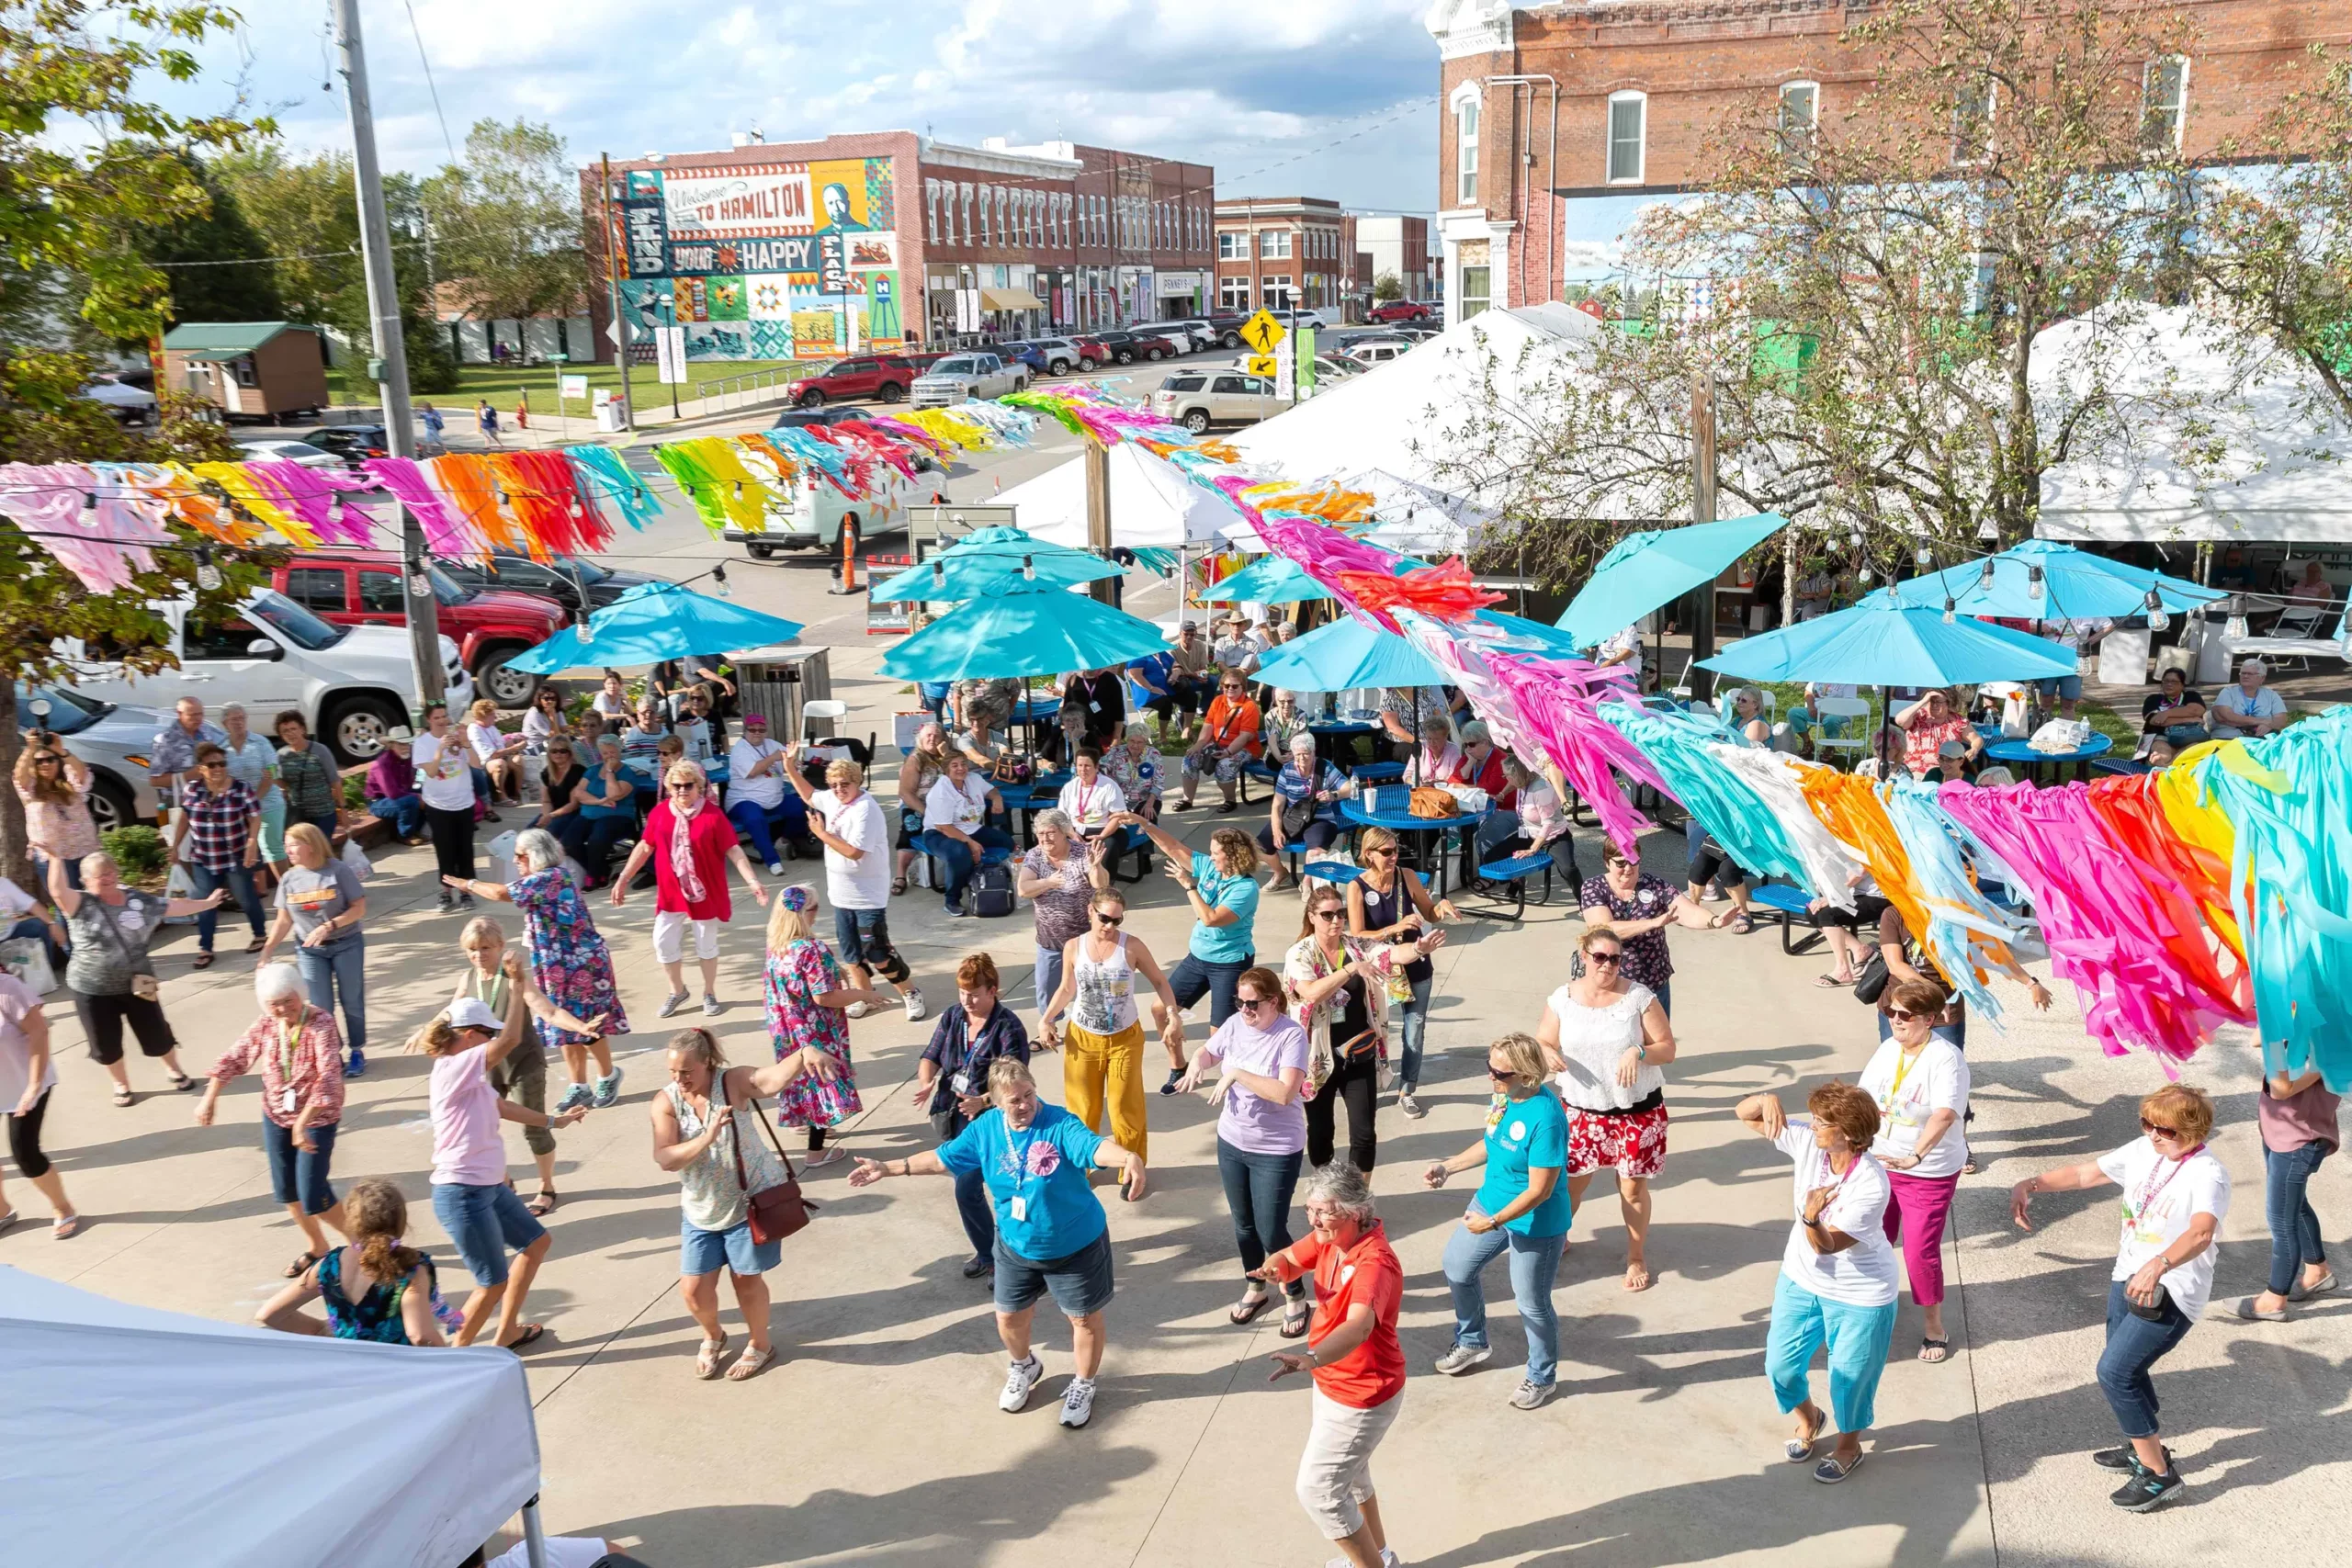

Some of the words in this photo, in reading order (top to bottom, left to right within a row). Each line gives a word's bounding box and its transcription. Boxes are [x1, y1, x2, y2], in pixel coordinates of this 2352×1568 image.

[670, 180, 748, 209] Welcome
[695, 204, 715, 222] TO
[720, 180, 806, 220] HAMILTON
[629, 208, 664, 274] FIND
[673, 246, 714, 272] YOUR
[742, 240, 811, 270] HAPPY
[823, 235, 843, 291] PLACE
[1077, 1011, 1109, 1031] SANTIAGO
